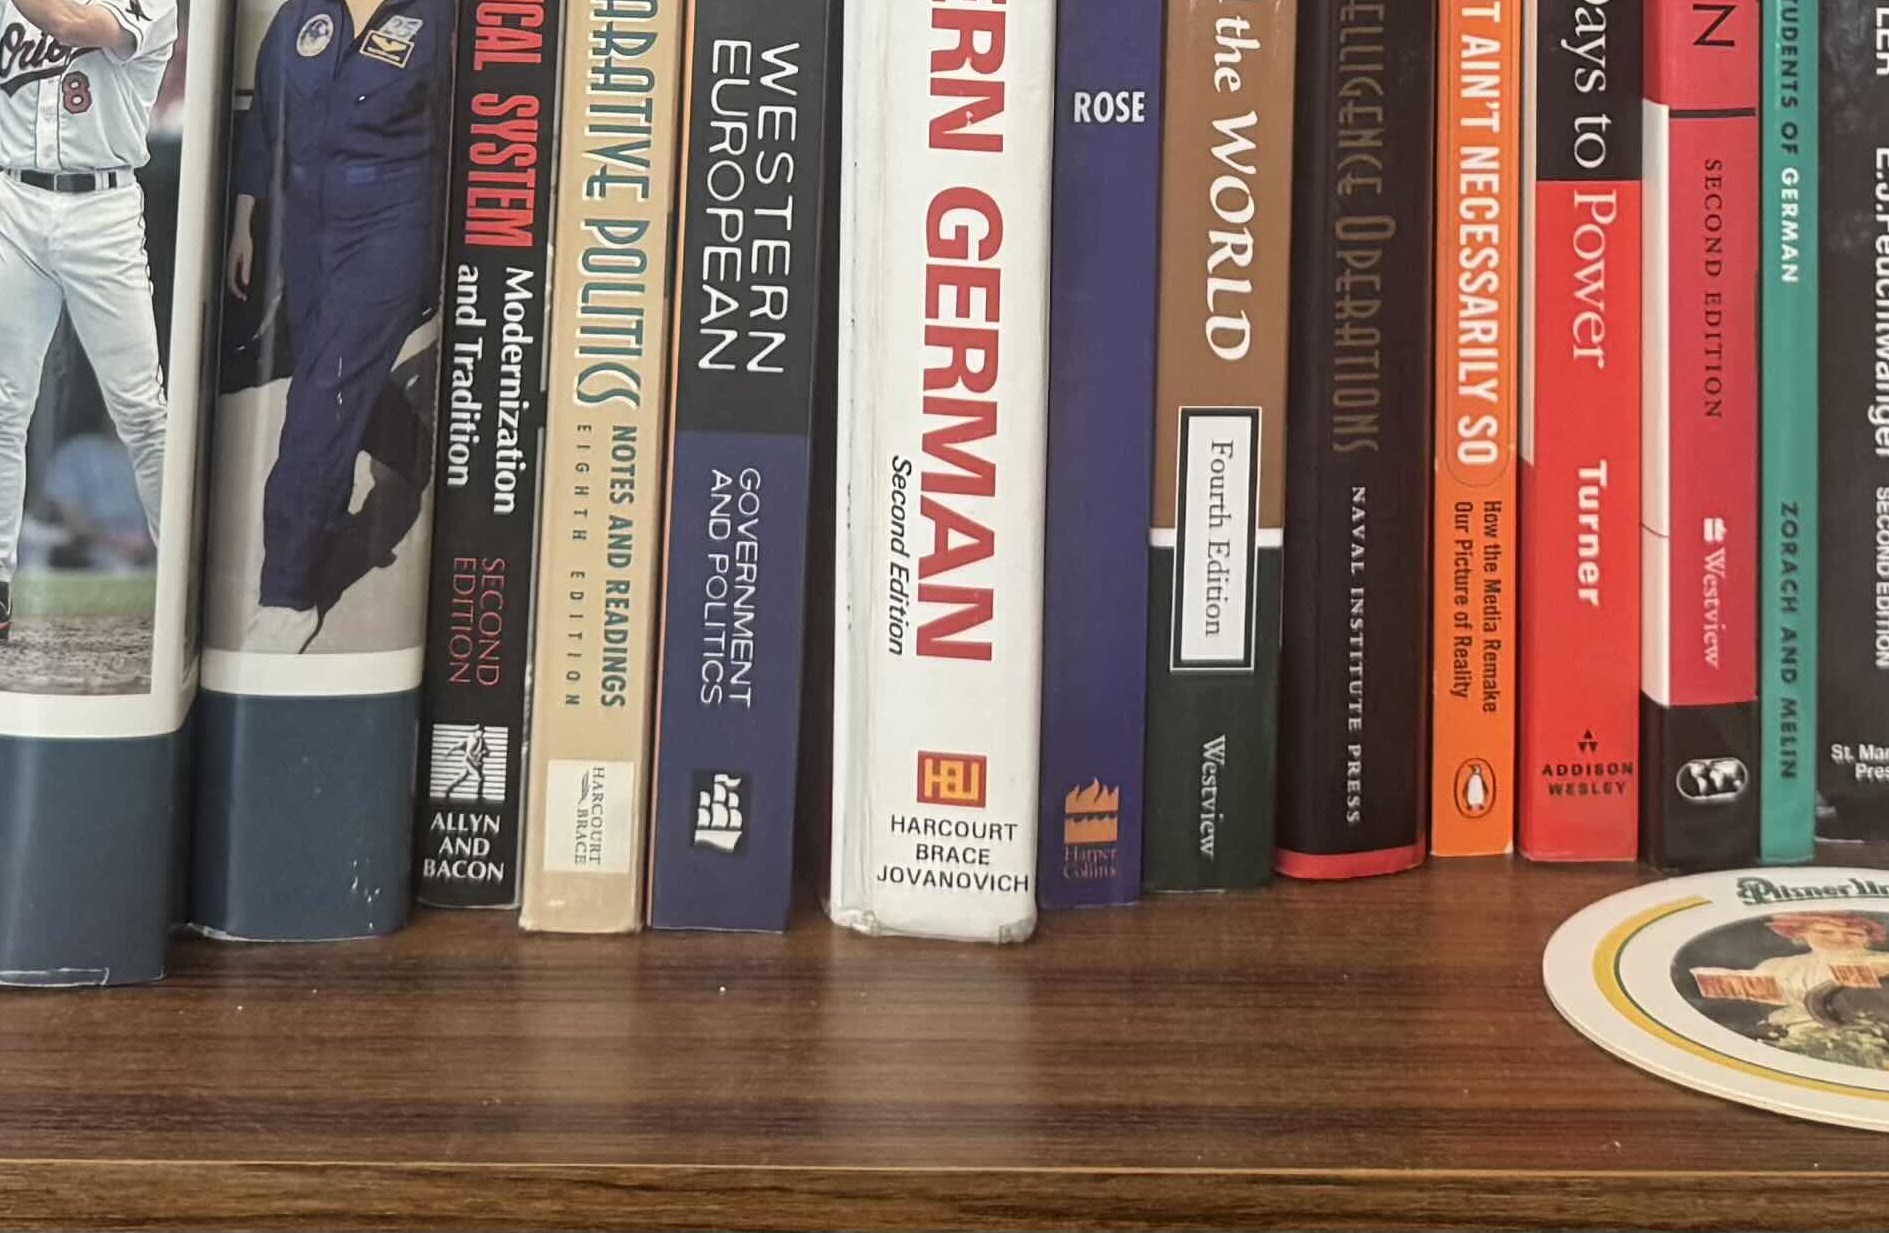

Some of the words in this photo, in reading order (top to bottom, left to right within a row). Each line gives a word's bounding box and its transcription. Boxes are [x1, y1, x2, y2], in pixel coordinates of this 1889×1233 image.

[62, 70, 92, 114] 8
[1073, 92, 1145, 124] ROSE
[1781, 121, 1799, 155] OF
[698, 39, 752, 371] EUROPEAN
[746, 42, 800, 374] WESTERN
[1702, 159, 1723, 279] SECOND
[1781, 167, 1799, 283] GERMAN
[456, 264, 478, 327] and
[492, 266, 534, 515] Modernization
[1703, 294, 1722, 419] EDITION
[447, 332, 482, 488] Tradition
[916, 186, 1004, 662] GERMAN
[609, 426, 637, 506] NOTES
[709, 469, 732, 542] AND
[1208, 440, 1236, 528] Fourth
[607, 516, 632, 569] AND
[889, 455, 912, 558] Second
[1351, 486, 1365, 574] NAVAL
[1454, 502, 1473, 533] Our
[1484, 501, 1502, 538] How
[1577, 460, 1610, 607] Turner
[728, 468, 761, 708] GOVERNMENT
[1204, 540, 1230, 638] Edition
[1454, 539, 1473, 605] Picture
[1483, 544, 1502, 573] the
[1780, 502, 1799, 613] ZORACH
[448, 557, 478, 685] EDITION
[473, 557, 505, 687] SECOND
[601, 580, 630, 707] READINGS
[700, 555, 729, 705] POLITICS
[888, 566, 910, 657] Edition
[1454, 611, 1472, 629] of
[1483, 579, 1502, 632] Media
[1348, 587, 1364, 731] INSTITUTE
[1450, 636, 1472, 699] Reality
[1483, 640, 1501, 712] Remake
[1780, 627, 1798, 685] AND
[1779, 699, 1797, 780] MELIN
[431, 813, 501, 835] ALLYN
[1199, 734, 1227, 857] Westview
[1346, 745, 1362, 824] PRESS
[439, 836, 491, 857] AND
[890, 814, 1019, 841] HARCOURT
[915, 843, 992, 866] BRACE
[423, 858, 504, 881] BACON
[876, 865, 1029, 893] JOVANOVICH
